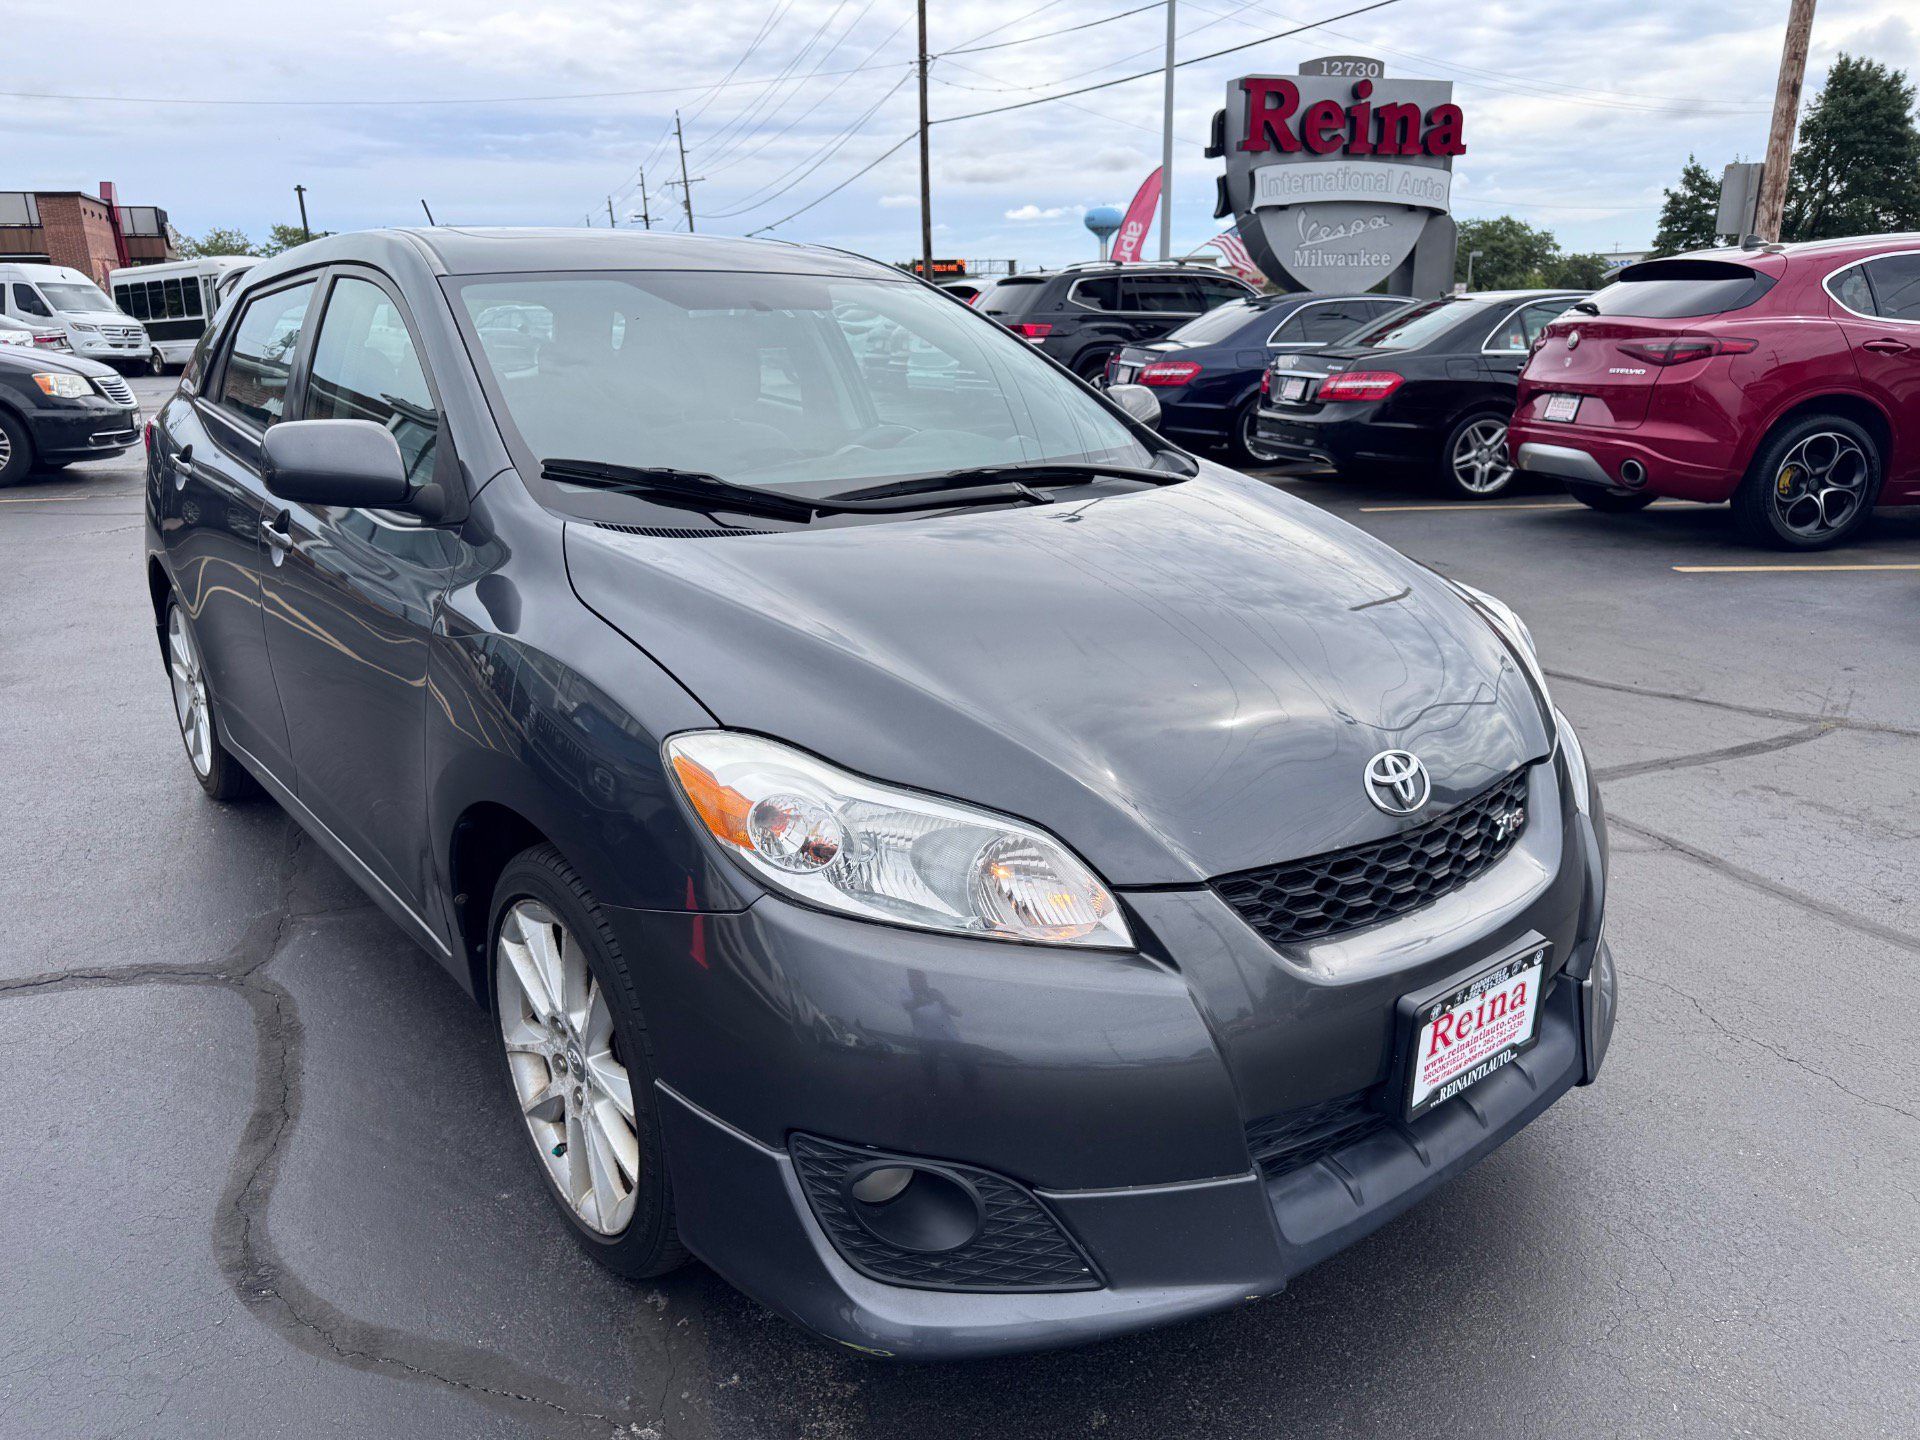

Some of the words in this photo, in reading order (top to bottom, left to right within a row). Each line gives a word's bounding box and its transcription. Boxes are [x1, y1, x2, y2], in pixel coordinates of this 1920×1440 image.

[1321, 61, 1380, 77] 12730
[1236, 77, 1467, 156] Reina
[1261, 168, 1393, 198] International
[1396, 171, 1444, 201] Auto
[1296, 207, 1391, 248] Vespa
[1293, 250, 1391, 268] Milwaukee
[1426, 981, 1527, 1059] Reina
